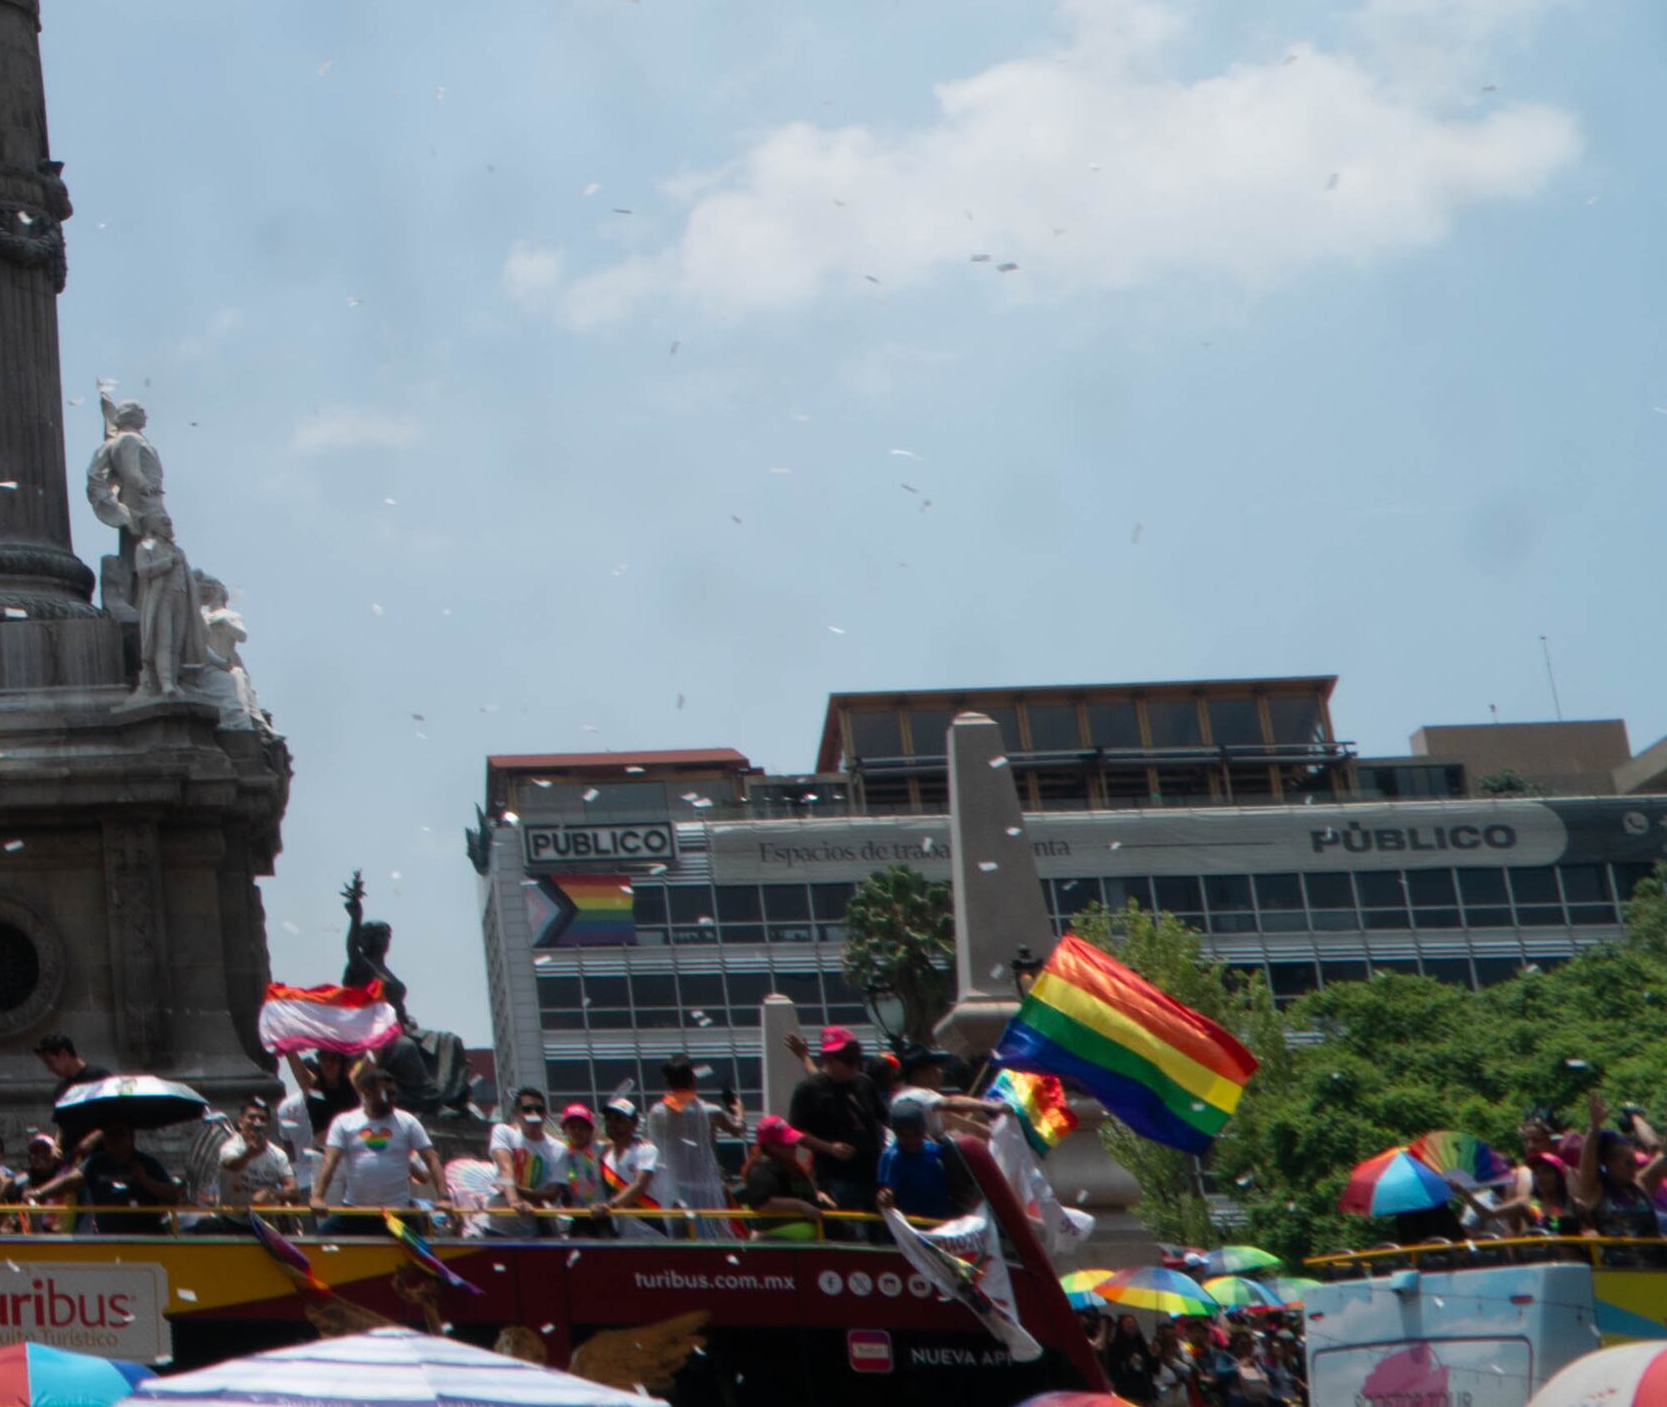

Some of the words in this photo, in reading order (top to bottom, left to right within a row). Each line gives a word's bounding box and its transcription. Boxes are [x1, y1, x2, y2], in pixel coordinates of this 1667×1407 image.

[1310, 821, 1517, 853] PÚBLICO
[757, 842, 855, 867] Espacios
[860, 841, 889, 861] de
[892, 838, 952, 860] traba
[1030, 840, 1072, 857] nta
[634, 1270, 796, 1290] turibus.com.mx
[910, 1348, 977, 1366] NUEVA
